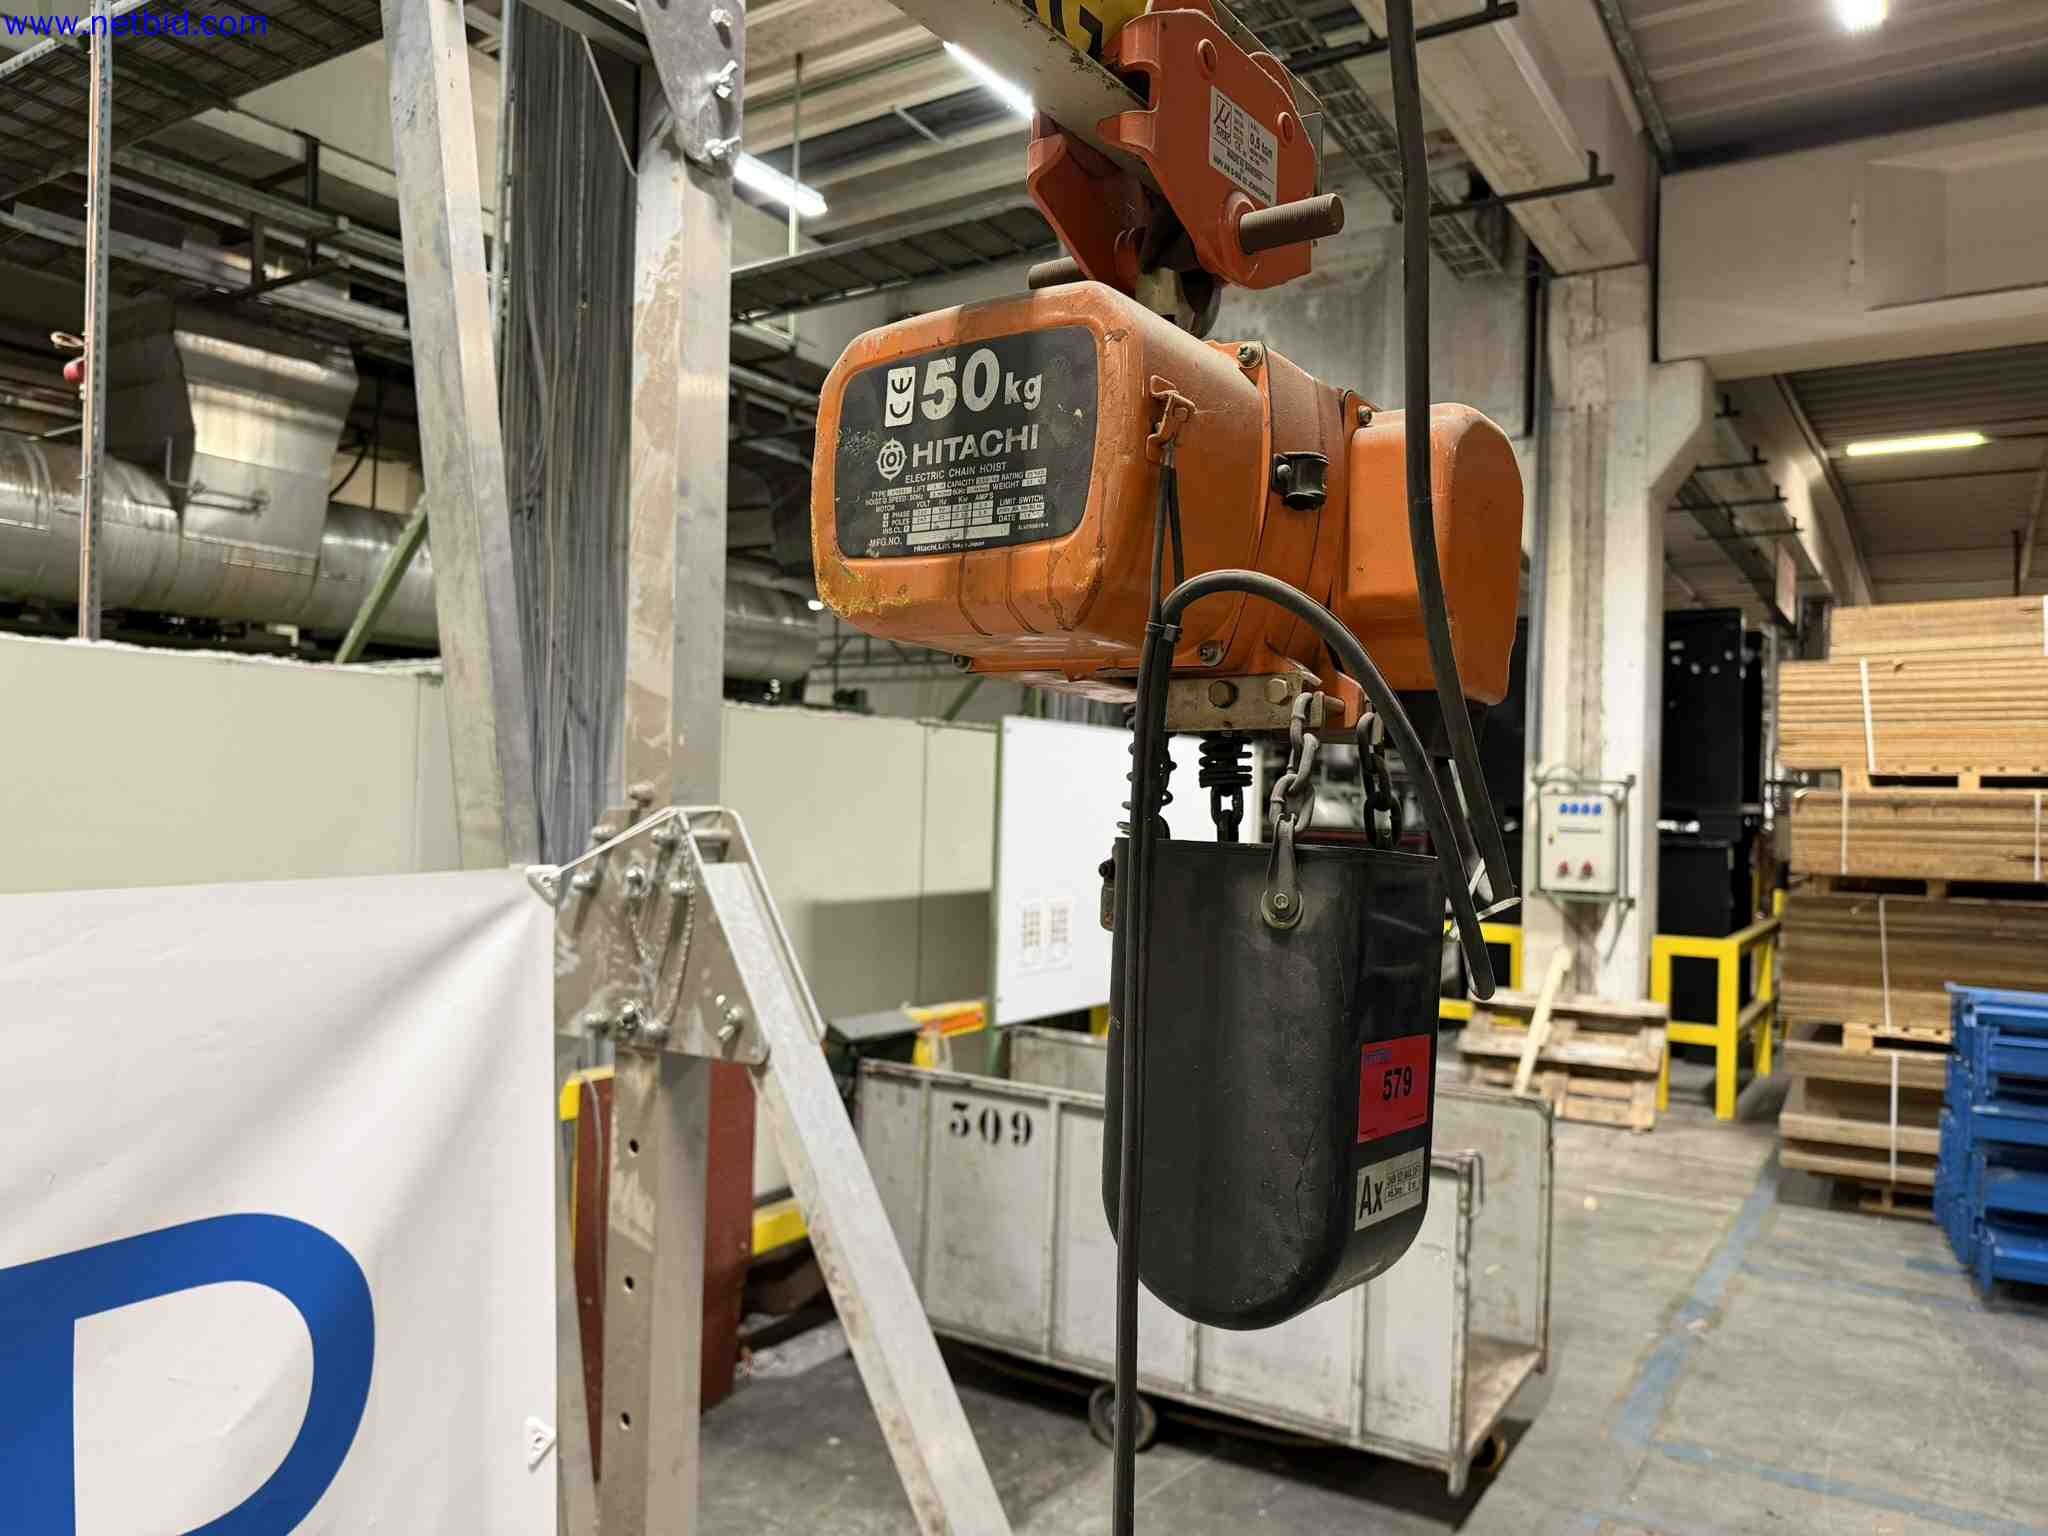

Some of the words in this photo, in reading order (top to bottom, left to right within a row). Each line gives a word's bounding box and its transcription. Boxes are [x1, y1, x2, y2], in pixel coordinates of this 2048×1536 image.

[920, 348, 1000, 420] 50
[1005, 371, 1042, 410] kg
[912, 424, 1039, 468] HITACHI
[905, 470, 945, 484] ELECTRIC
[949, 466, 976, 478] CHAIN
[980, 461, 1007, 473] HOIST
[913, 485, 926, 493] LIFT
[947, 479, 976, 488] CAPACITY
[1002, 472, 1024, 481] RATING
[992, 480, 1020, 490] WEIGHT
[916, 500, 930, 508] VOLT
[1000, 497, 1016, 506] LIMIT
[1019, 494, 1044, 504] SWITCH
[999, 514, 1016, 522] DATE
[1382, 1066, 1412, 1100] 579
[1360, 1176, 1383, 1218] Ax
